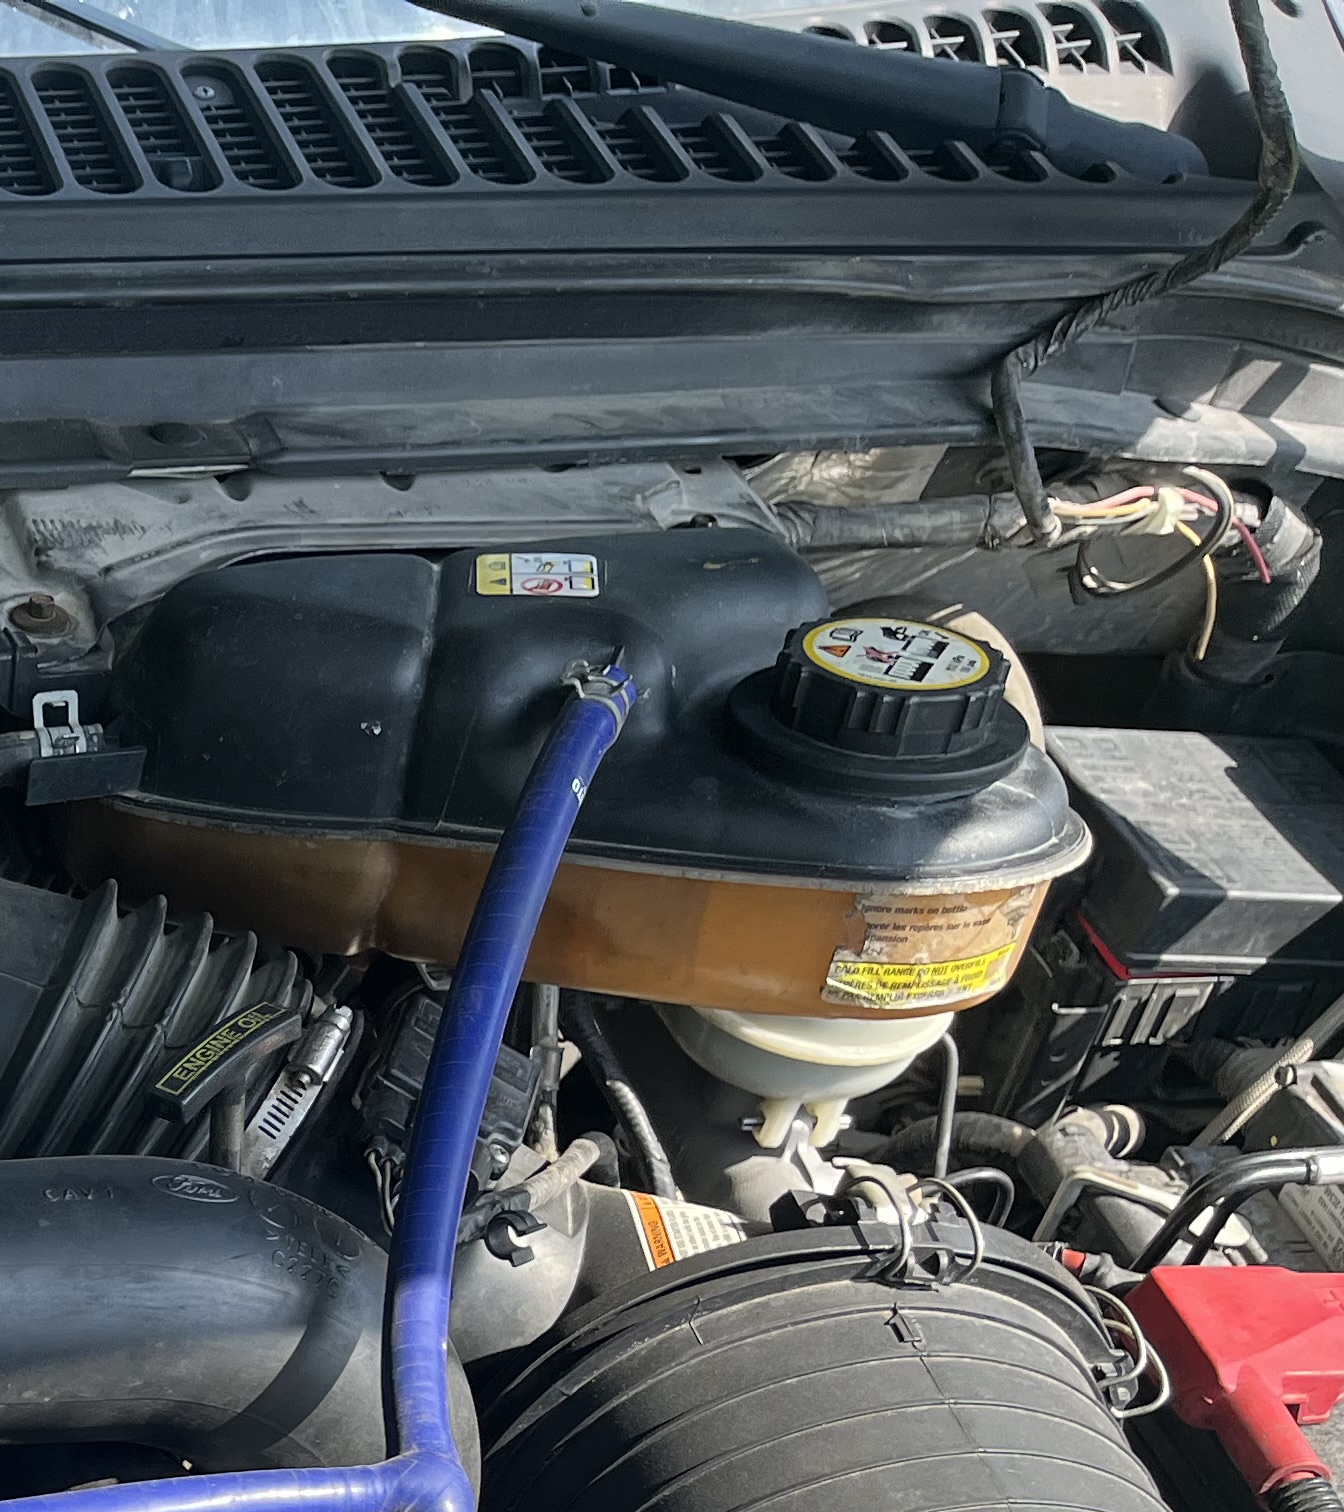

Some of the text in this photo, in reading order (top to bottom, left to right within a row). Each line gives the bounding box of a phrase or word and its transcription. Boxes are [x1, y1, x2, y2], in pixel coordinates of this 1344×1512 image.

[894, 906, 924, 914] marks
[926, 907, 939, 915] on
[941, 904, 969, 913] bottle
[862, 966, 880, 976] FILL
[884, 966, 914, 976] RANGE
[931, 965, 948, 975] NOT
[173, 1011, 273, 1081] ENGINE OIL
